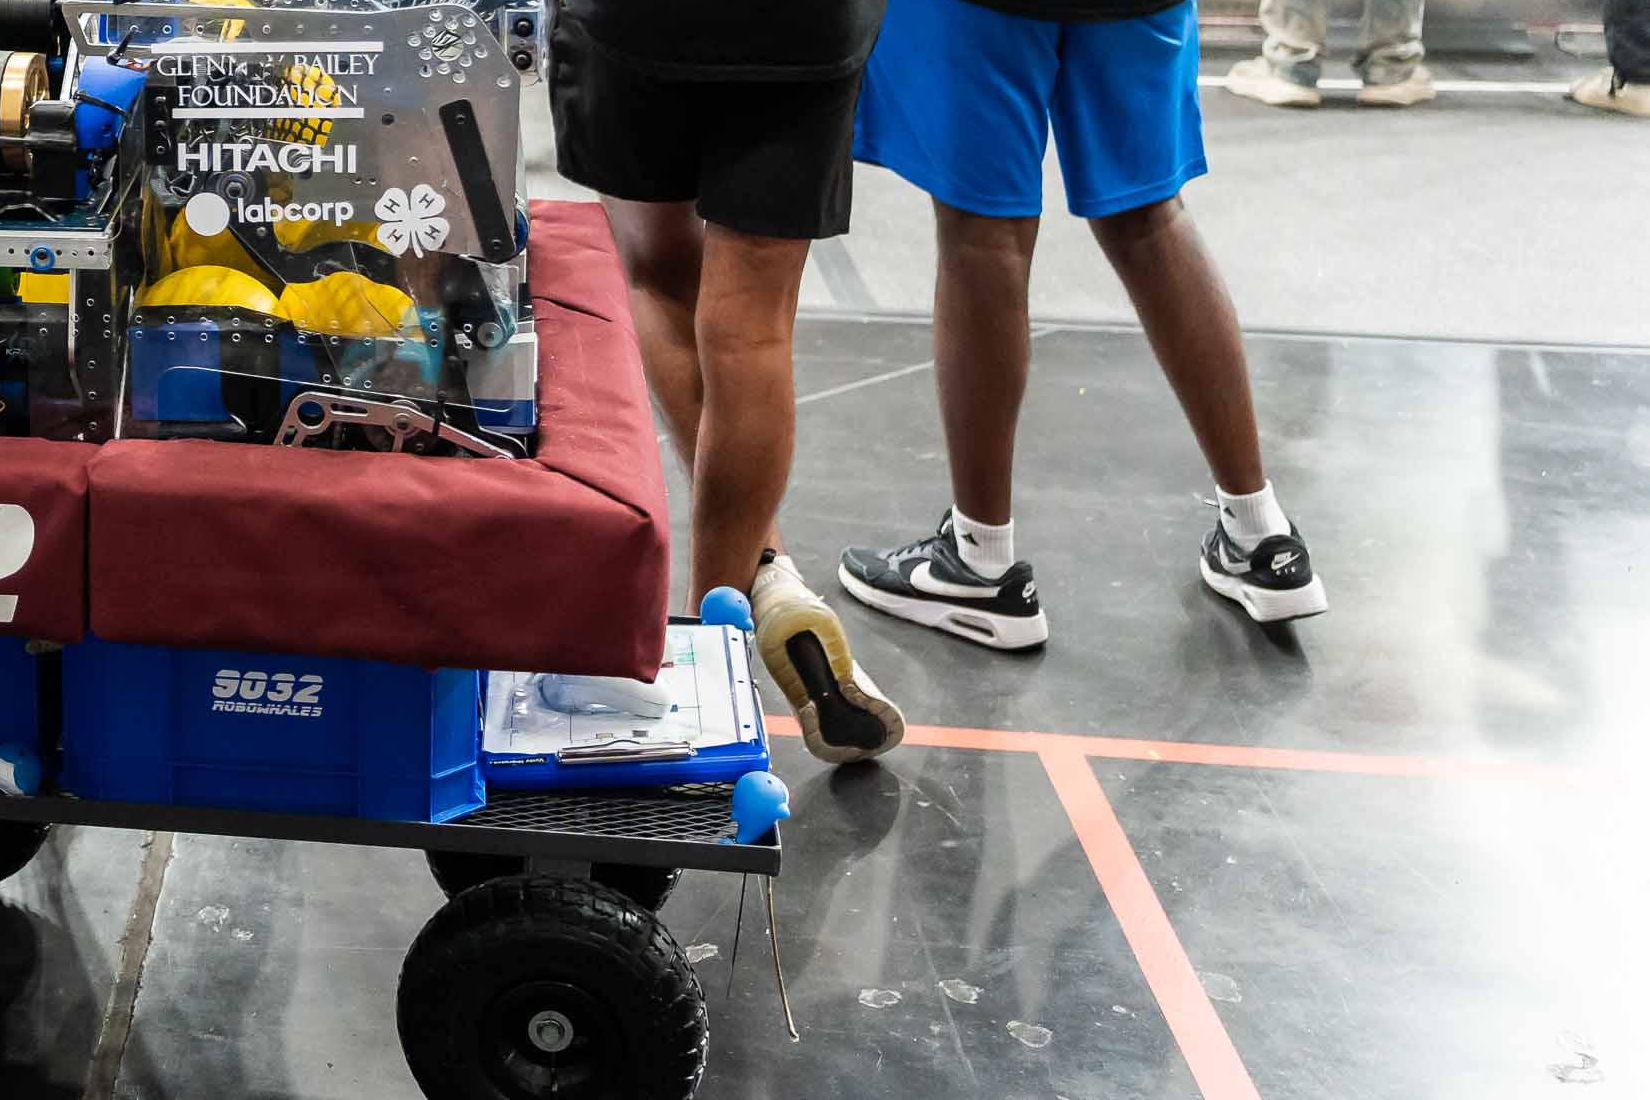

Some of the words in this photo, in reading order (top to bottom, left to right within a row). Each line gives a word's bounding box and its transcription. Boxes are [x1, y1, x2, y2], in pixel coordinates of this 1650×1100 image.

[294, 54, 379, 76] BAILEY
[178, 85, 358, 107] FOUNDATION
[177, 143, 357, 173] HITACHI
[238, 197, 354, 227] labcorp
[212, 669, 323, 703] 9032
[212, 701, 323, 717] ROBOWHALES
